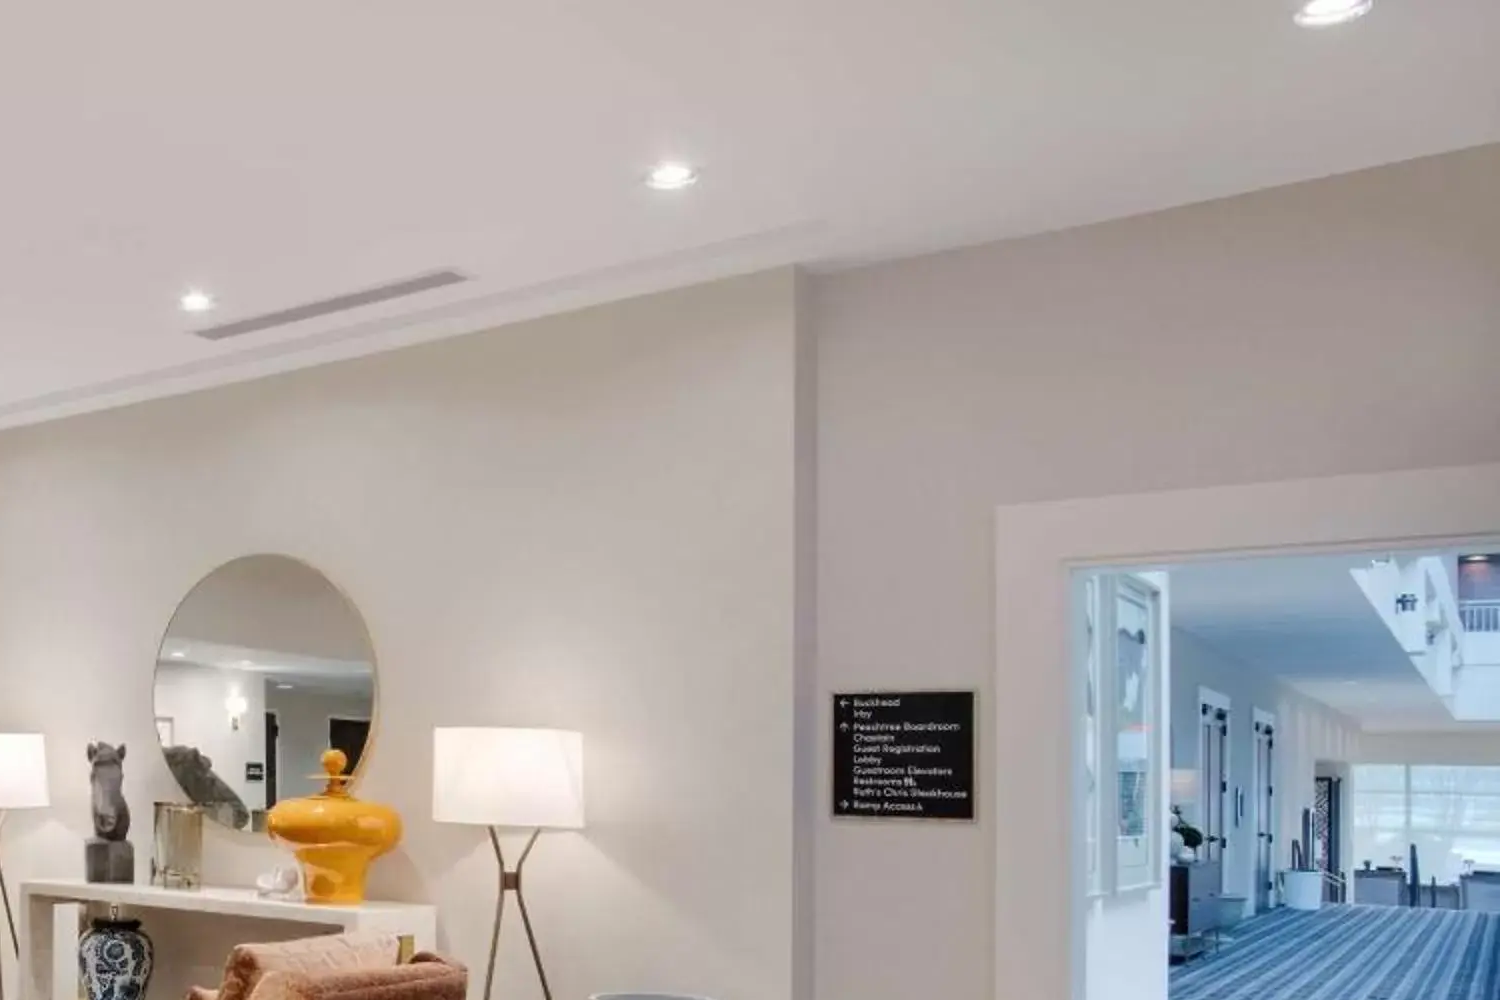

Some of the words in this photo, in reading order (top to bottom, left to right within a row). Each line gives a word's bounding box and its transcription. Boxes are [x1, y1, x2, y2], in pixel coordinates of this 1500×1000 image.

[853, 698, 901, 707] Buckhead
[853, 722, 901, 731] Peachtree
[903, 721, 961, 731] Boardroom
[853, 744, 880, 753] Guest
[882, 744, 941, 754] Registration
[853, 755, 882, 765] Lobby
[853, 766, 904, 775] Guestroom
[907, 765, 953, 776] Elevators
[853, 777, 902, 786] Restrooms
[883, 788, 908, 797] Chris
[910, 789, 968, 799] Steakhouse
